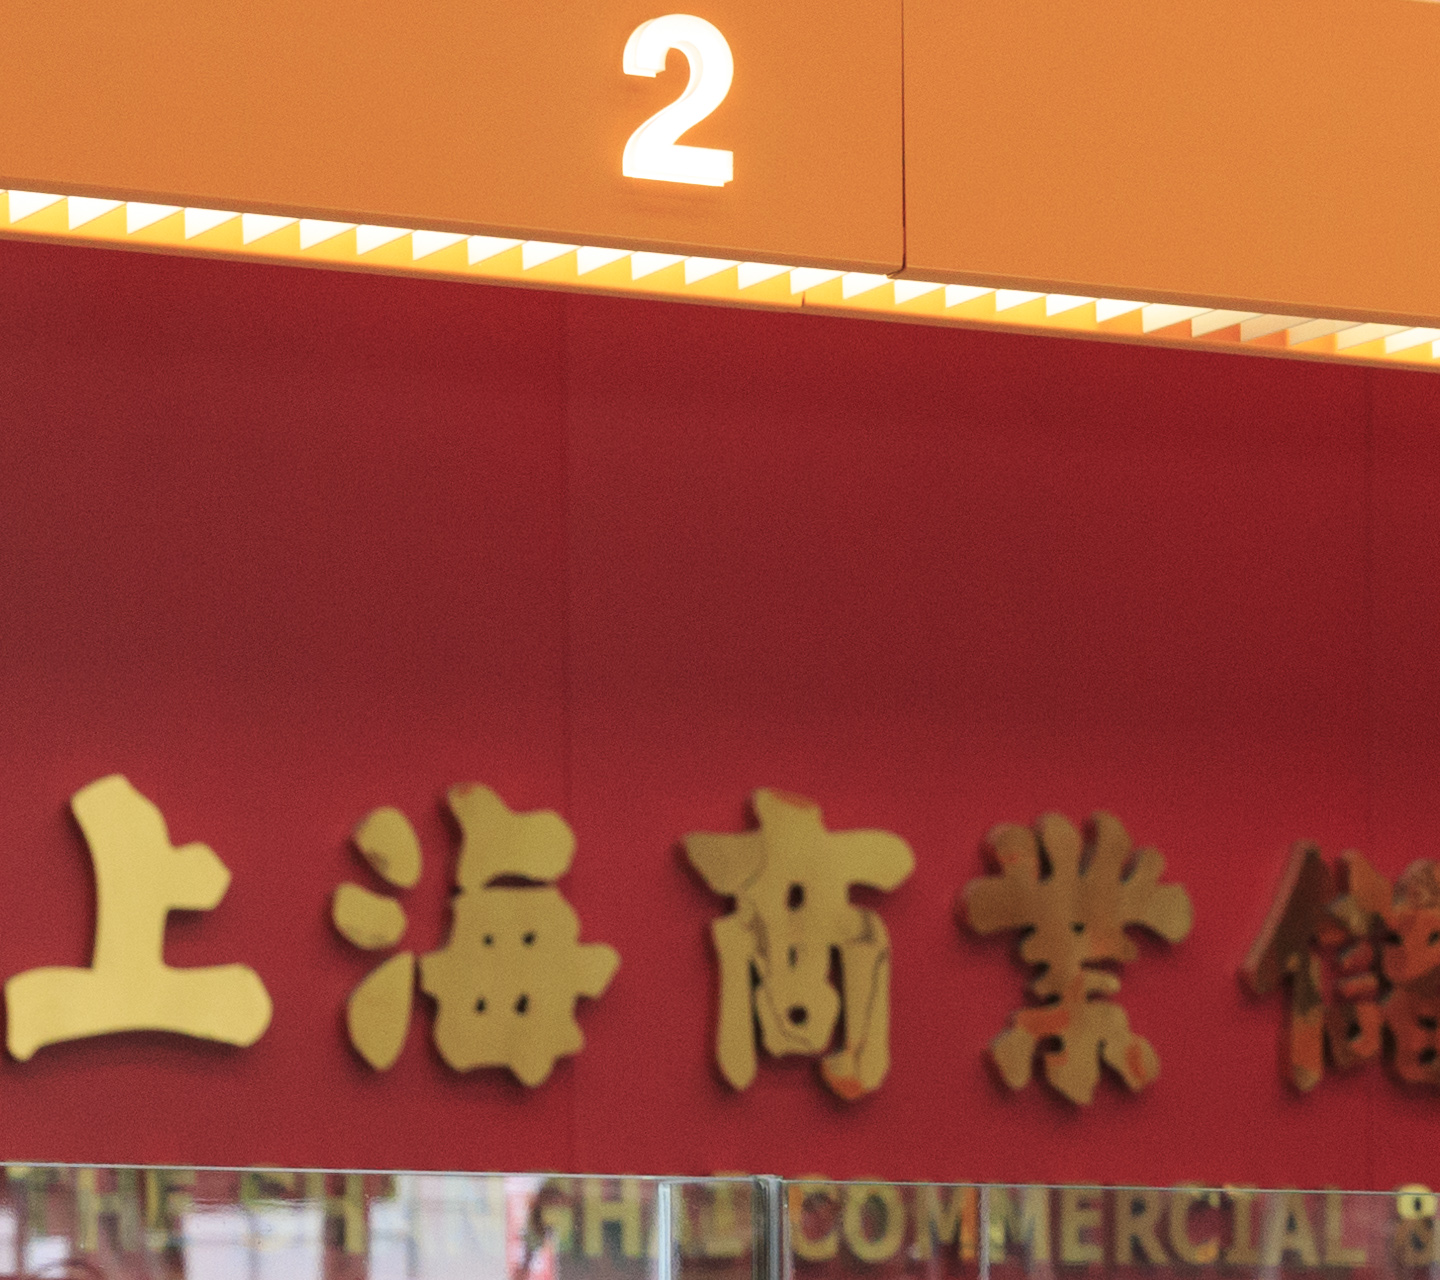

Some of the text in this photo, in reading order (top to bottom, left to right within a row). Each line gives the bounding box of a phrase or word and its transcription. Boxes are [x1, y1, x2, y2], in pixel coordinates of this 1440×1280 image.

[622, 13, 734, 187] 2
[240, 1166, 756, 1258] SHGHAI
[786, 1176, 1368, 1268] COMMERCIAL
